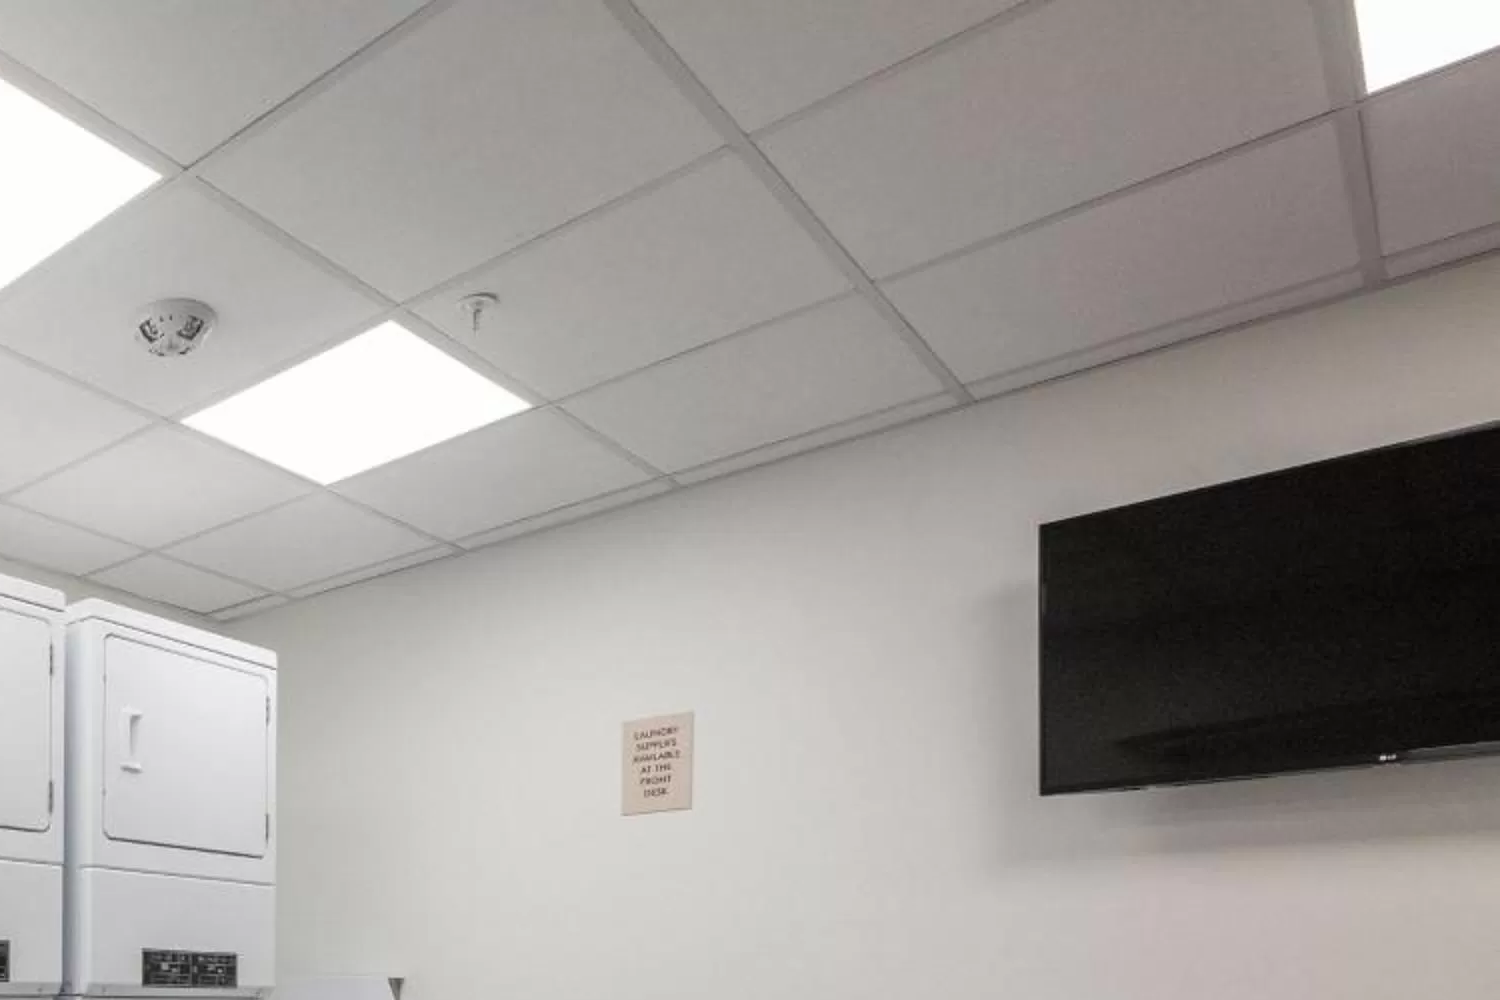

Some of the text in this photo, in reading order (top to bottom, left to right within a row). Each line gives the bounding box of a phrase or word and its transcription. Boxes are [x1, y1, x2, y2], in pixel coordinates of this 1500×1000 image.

[634, 727, 678, 740] LAUNDRY
[641, 763, 671, 773] AT THE
[640, 775, 671, 785] FRONT
